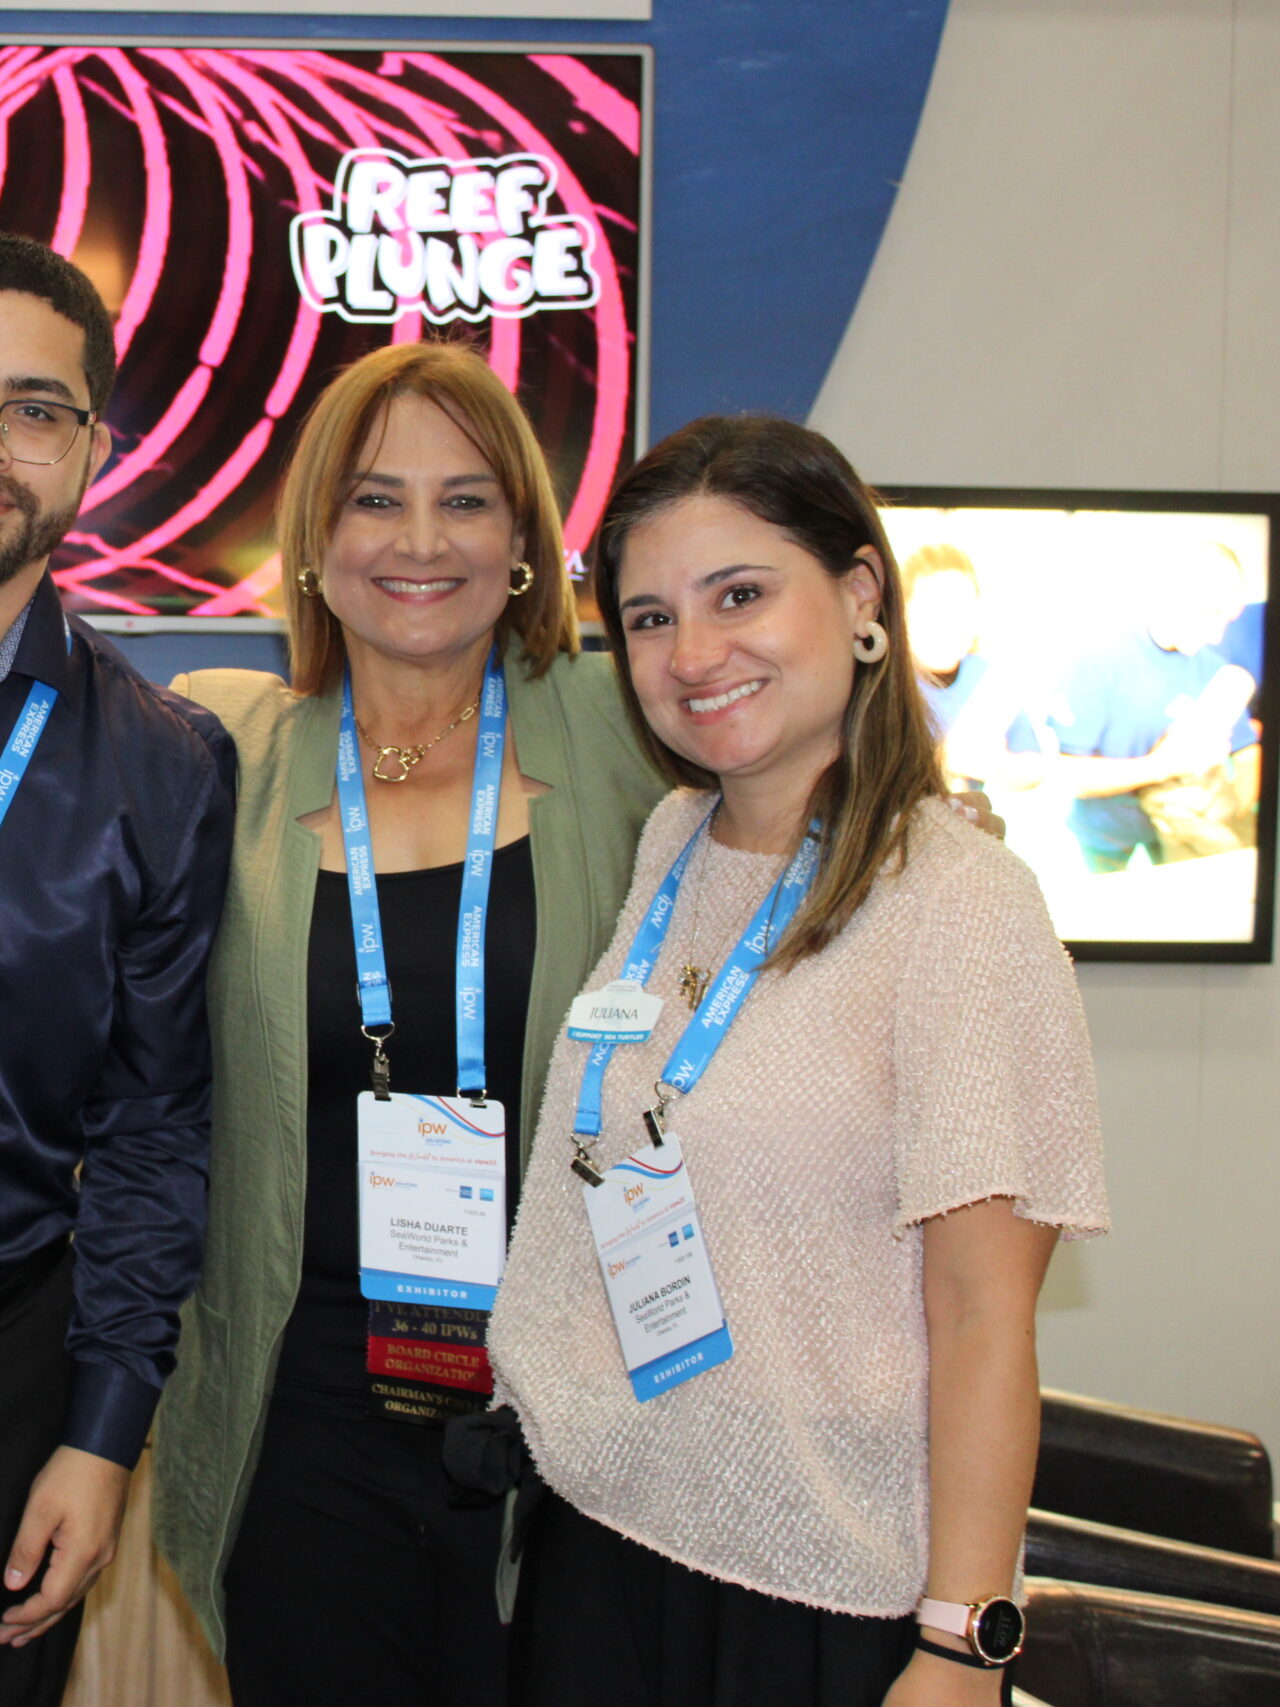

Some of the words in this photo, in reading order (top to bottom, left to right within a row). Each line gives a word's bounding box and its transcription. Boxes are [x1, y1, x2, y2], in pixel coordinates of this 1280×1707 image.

[346, 160, 545, 236] REEF
[303, 223, 589, 310] PLUNGE
[11, 702, 40, 753] EXPRESS
[19, 700, 50, 757] AMERICAN
[480, 731, 502, 759] ipw
[473, 789, 487, 835] EXPRESS
[482, 784, 496, 836] AMERICAN
[349, 847, 363, 896] AMERICAN
[358, 845, 372, 889] EXPRESS
[468, 849, 490, 877] ipw
[650, 893, 674, 928] ipw
[358, 923, 380, 953] ipw
[461, 912, 473, 967] EXPRESS
[471, 905, 483, 967] AMERICAN
[460, 986, 482, 1020] ipw
[589, 1007, 639, 1020] JULIANA
[702, 965, 742, 1029] AMERICAN
[714, 971, 751, 1026] EXPRESS
[672, 1059, 696, 1089] pw
[418, 1118, 447, 1137] ipw
[370, 1172, 395, 1187] ipw
[623, 1182, 644, 1206] ipw
[390, 1218, 421, 1230] LISHA
[424, 1222, 468, 1236] DUARTE
[390, 1229, 432, 1243] SeaWorld
[434, 1235, 459, 1246] Parks
[398, 1242, 459, 1258] Entertainment
[396, 1284, 468, 1299] EXHIBITOR
[629, 1291, 660, 1314] JULIANA
[660, 1274, 691, 1298] BORDIN
[392, 1319, 409, 1333] 36
[421, 1322, 437, 1335] 40
[440, 1323, 478, 1340] IPWs
[410, 1305, 489, 1323] ATTENDE
[387, 1344, 433, 1360] BOARD
[434, 1351, 480, 1368] CIRCLE
[653, 1351, 705, 1384] EXHIBITOR
